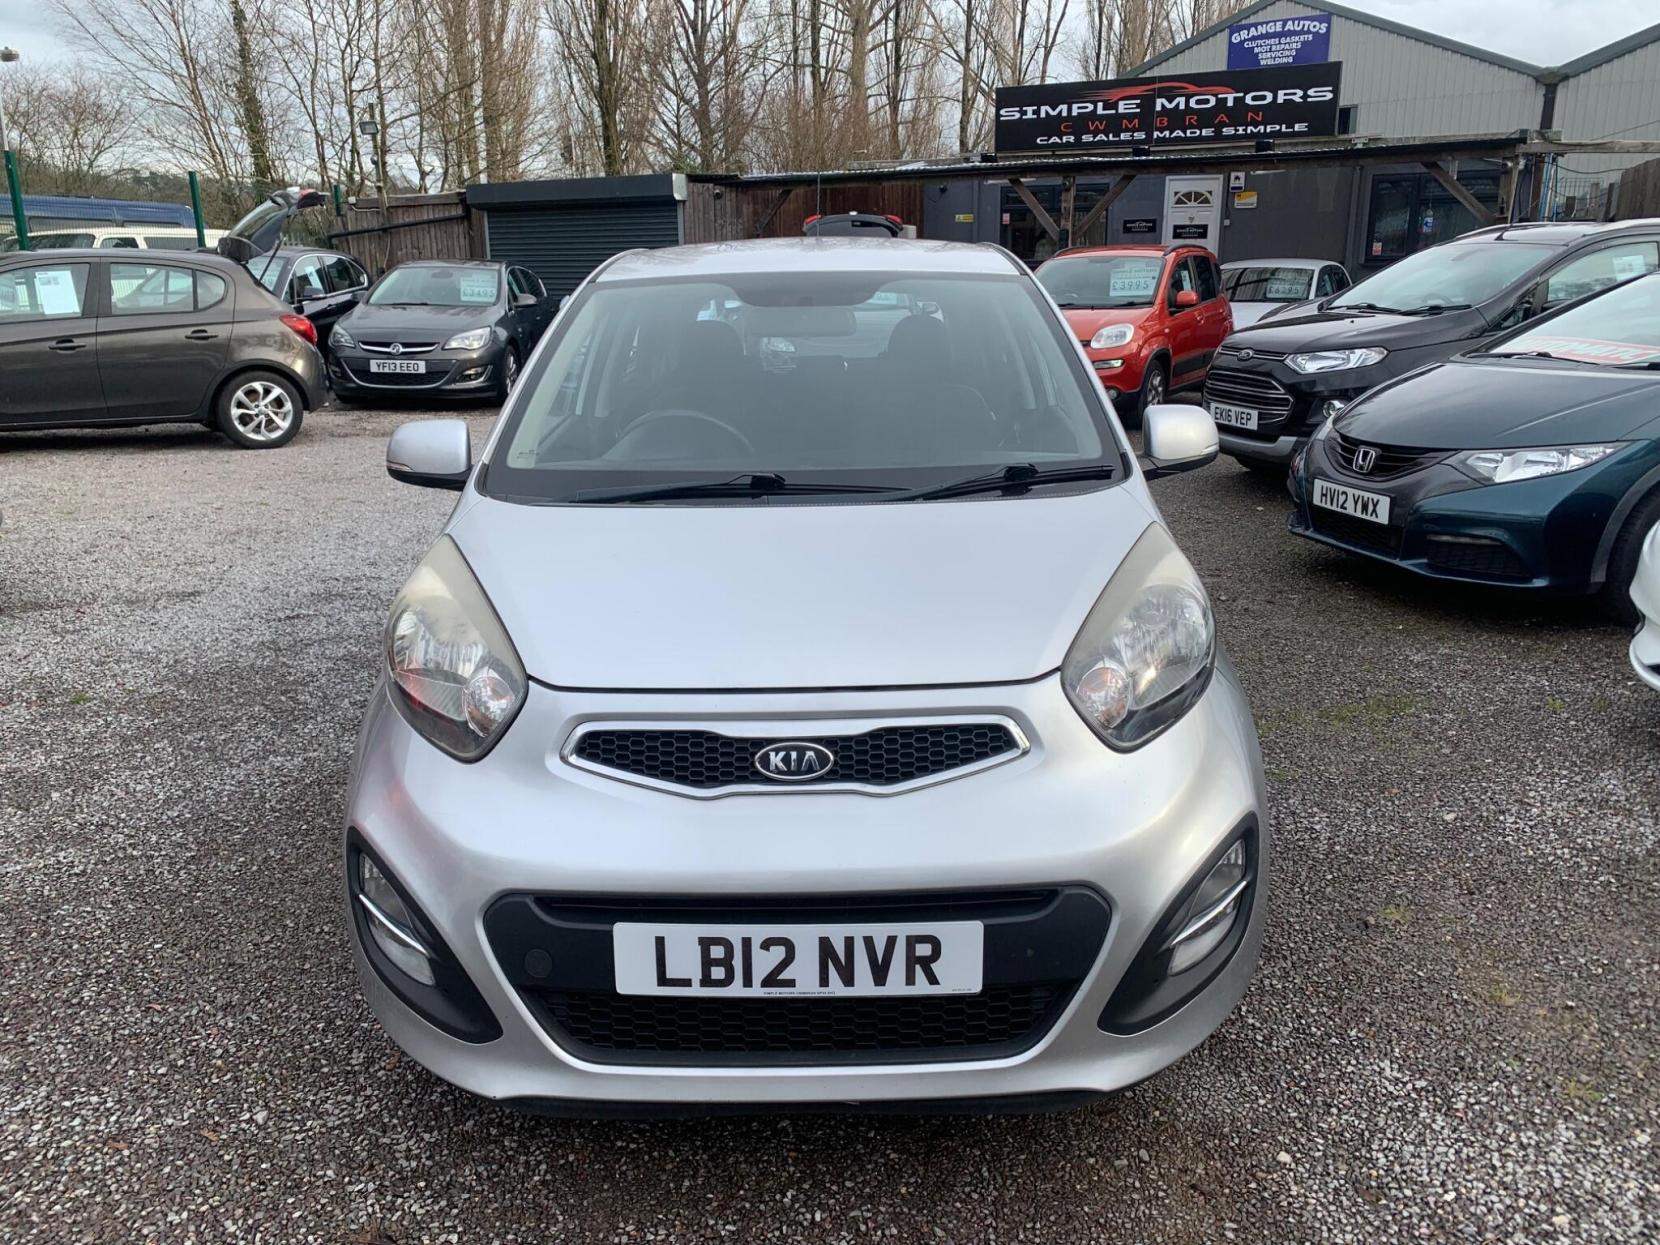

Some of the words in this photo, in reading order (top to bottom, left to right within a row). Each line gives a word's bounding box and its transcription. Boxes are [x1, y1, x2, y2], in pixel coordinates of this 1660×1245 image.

[1231, 21, 1283, 43] GRANGE
[1284, 20, 1328, 34] AUTOS
[1244, 37, 1279, 48] CLUTCHES
[1280, 34, 1313, 44] GASKETS
[1254, 46, 1271, 54] MOT
[1271, 42, 1302, 51] REPAIRS
[1258, 49, 1296, 59] SERVICING
[1260, 57, 1293, 66] WELDING
[1000, 99, 1141, 120] SIMPLE
[1156, 86, 1334, 111] MOTORS
[1060, 111, 1263, 132] CWMBRAN
[1036, 135, 1076, 144] CAR
[1081, 131, 1146, 142] SALES
[1153, 127, 1215, 139] MADE
[1222, 123, 1309, 135] SIMPLE
[376, 362, 397, 372] YF13
[400, 362, 419, 372] EEO
[1214, 406, 1233, 423] EK16
[1234, 409, 1252, 427] VEP
[1320, 484, 1349, 511] HV12
[1352, 493, 1380, 519] YWX
[768, 750, 821, 771] KIA
[654, 935, 797, 988] LB12
[818, 934, 942, 988] NVR
